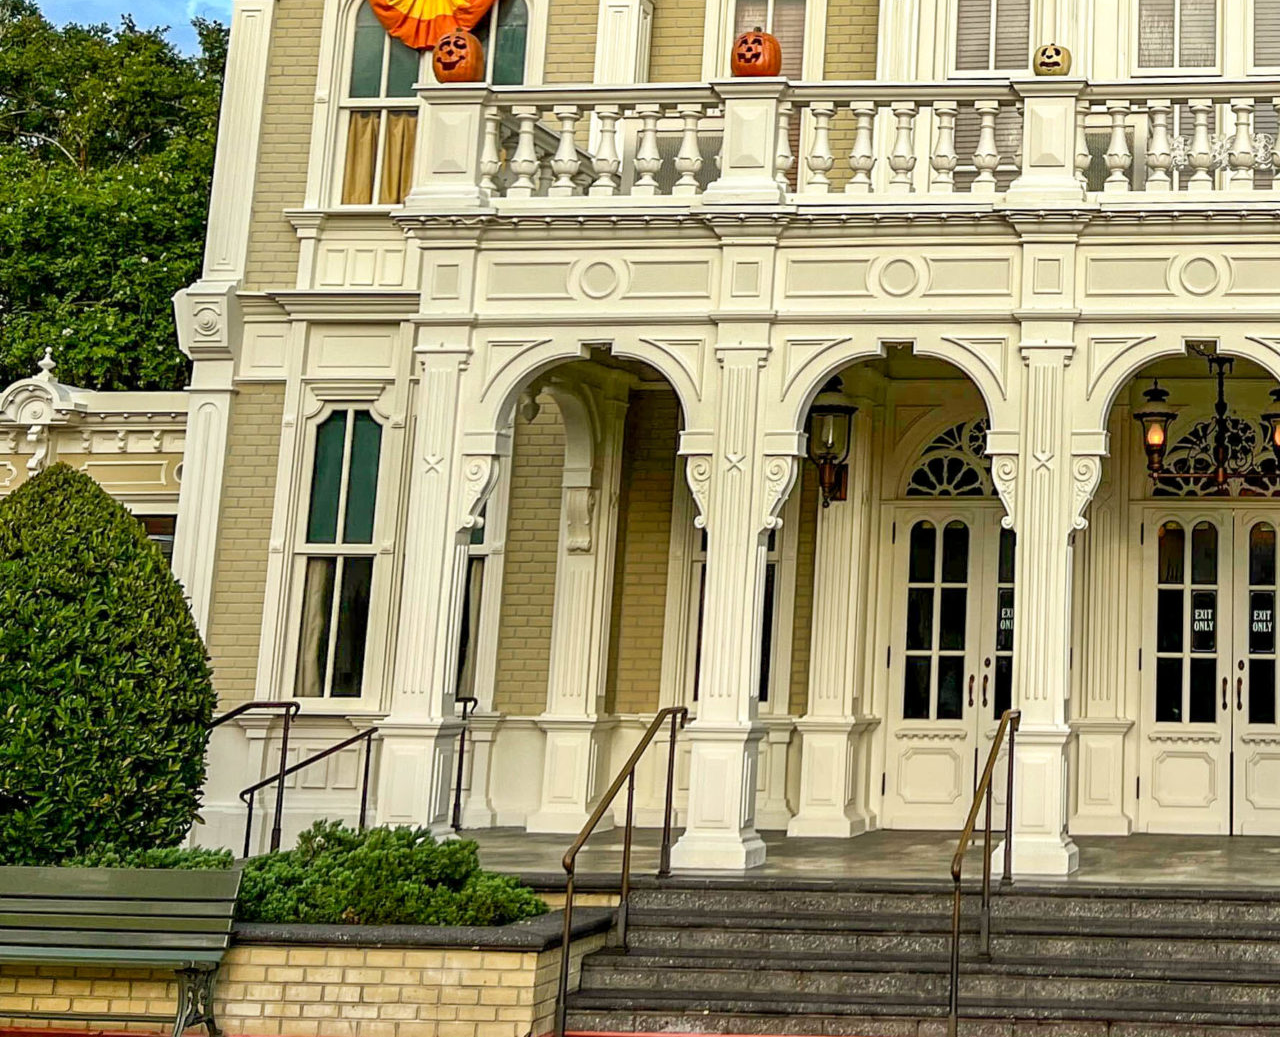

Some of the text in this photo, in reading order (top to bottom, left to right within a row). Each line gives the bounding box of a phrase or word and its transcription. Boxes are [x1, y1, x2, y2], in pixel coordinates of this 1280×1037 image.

[1001, 608, 1014, 619] EXI
[1195, 609, 1213, 620] EXIT
[1253, 610, 1272, 621] EXIT
[1193, 620, 1214, 631] ONLY
[1252, 621, 1273, 632] ONLY
